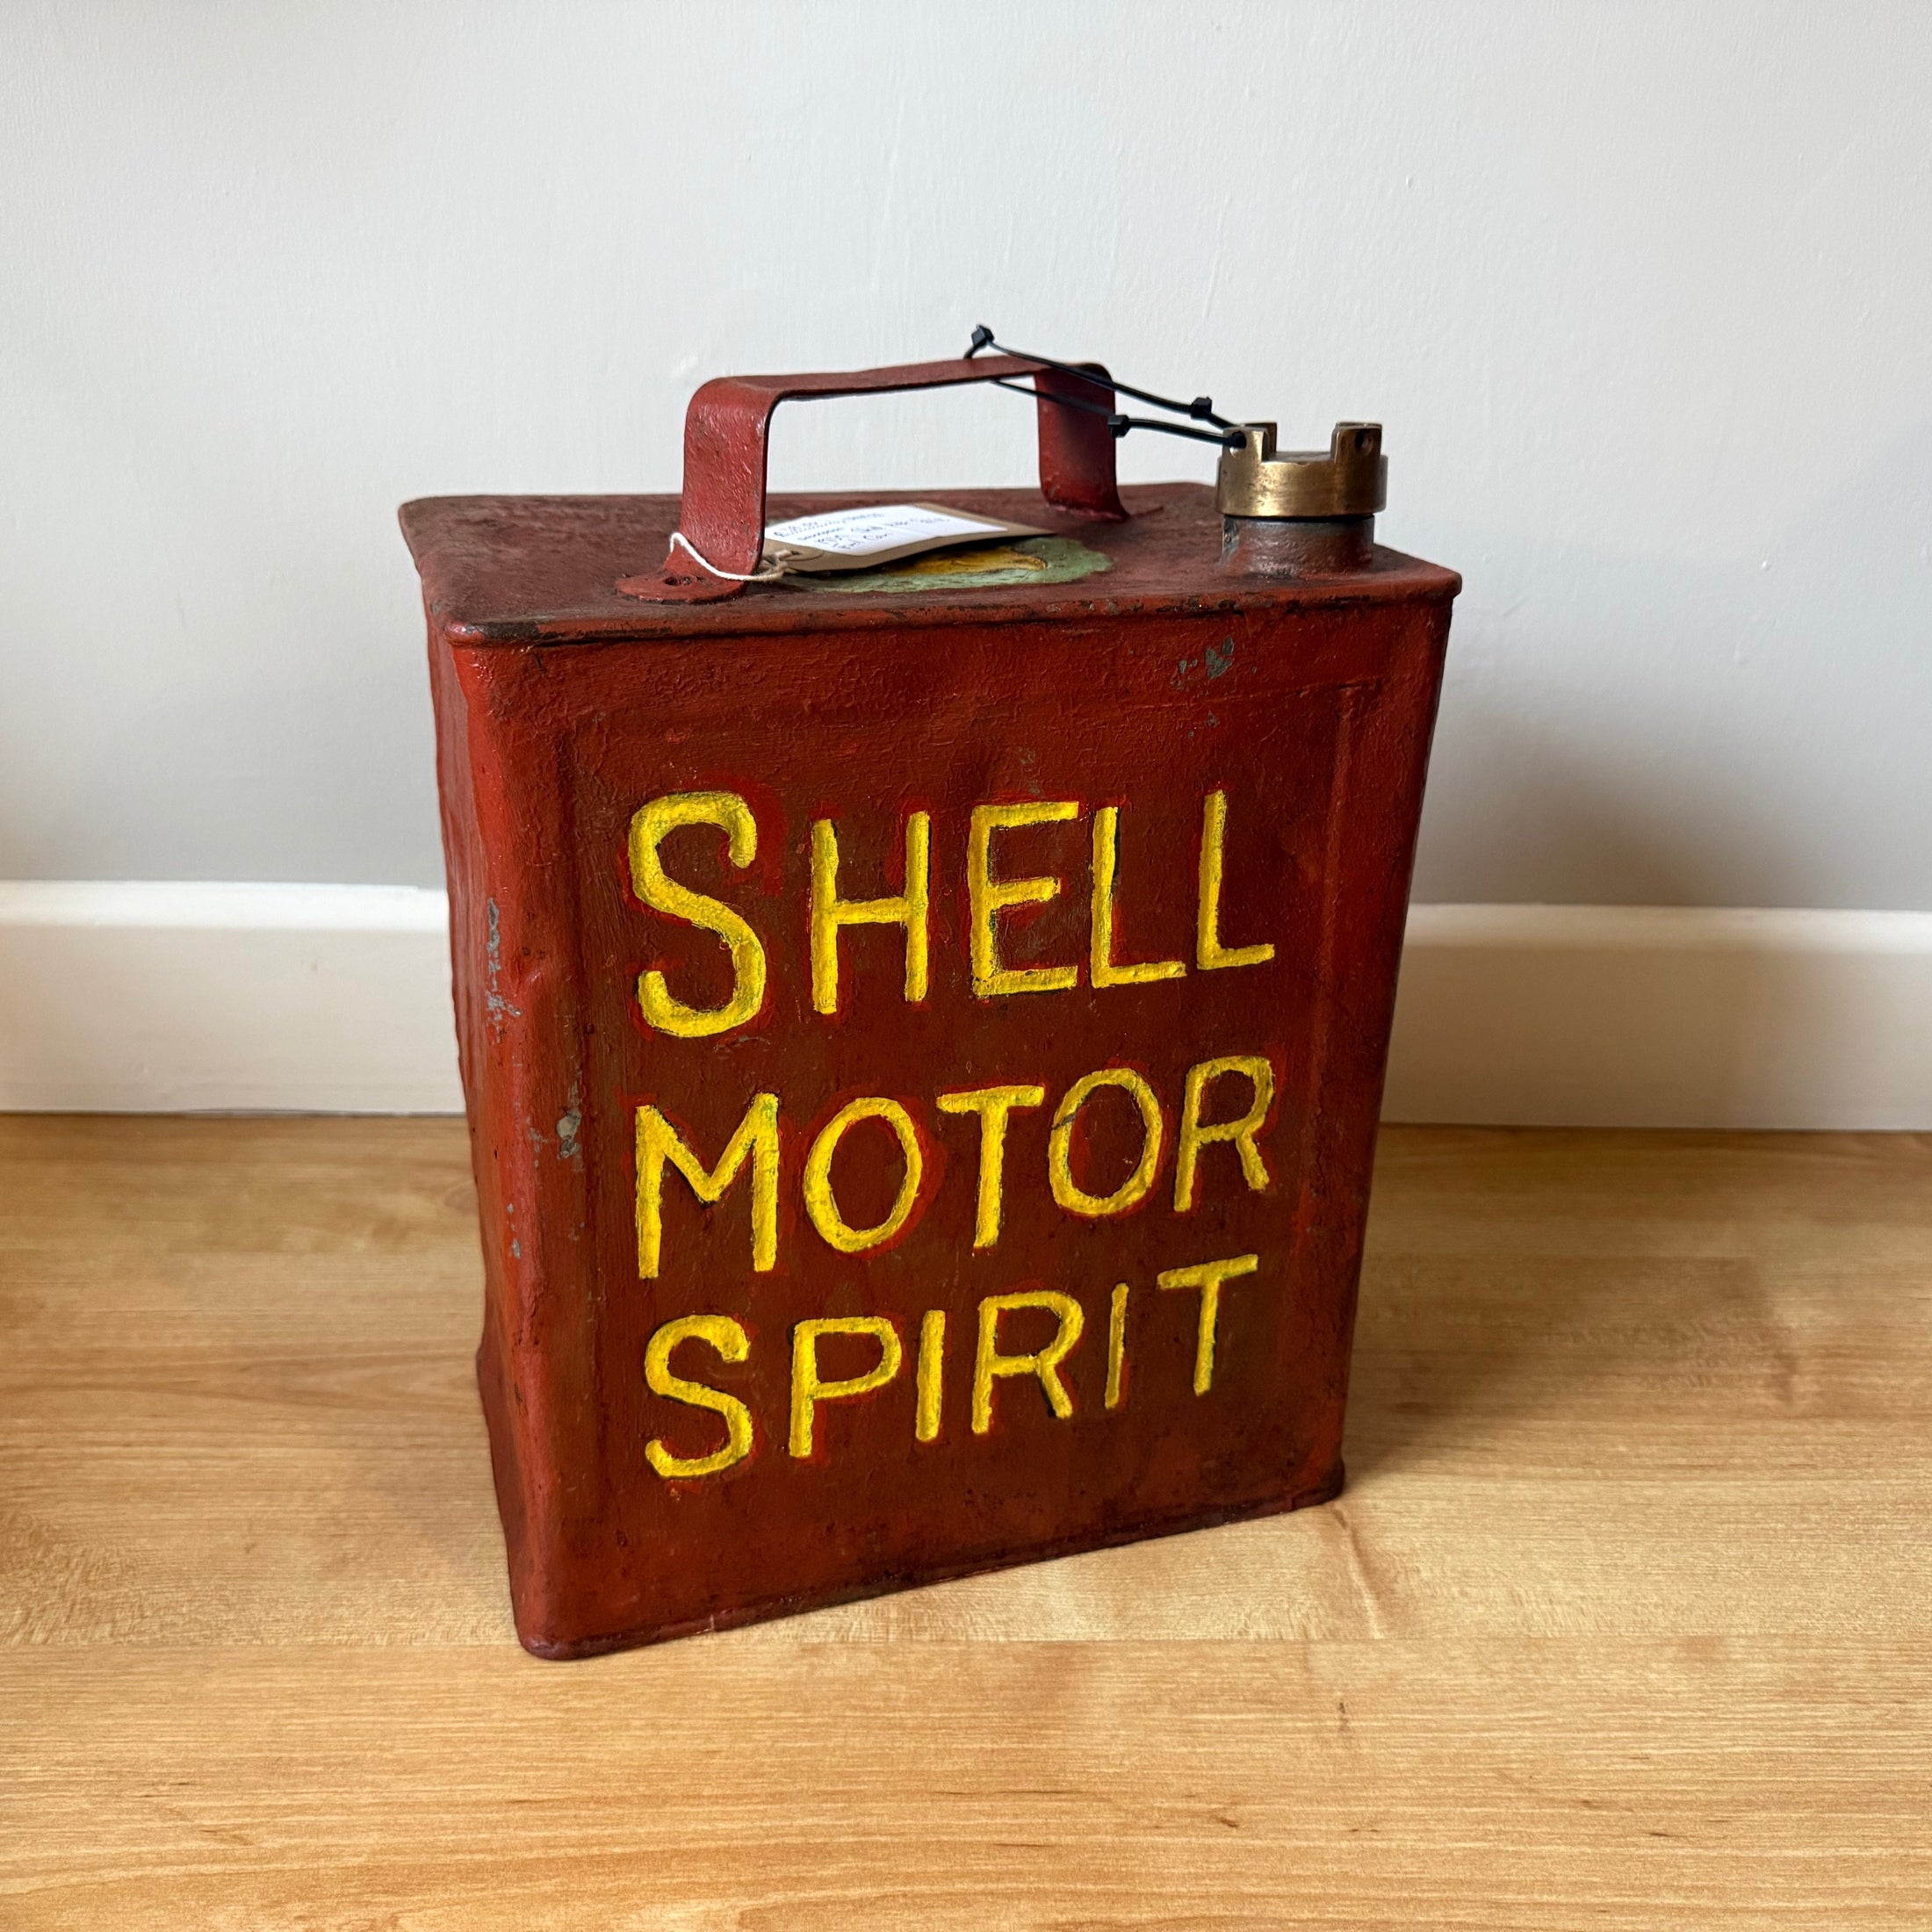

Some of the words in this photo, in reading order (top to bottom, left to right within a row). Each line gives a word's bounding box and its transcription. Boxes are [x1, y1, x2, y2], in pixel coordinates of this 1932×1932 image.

[629, 789, 1276, 1039] SHELL
[633, 1055, 1275, 1280] MOTOR
[644, 1253, 1259, 1479] SPIRIT
